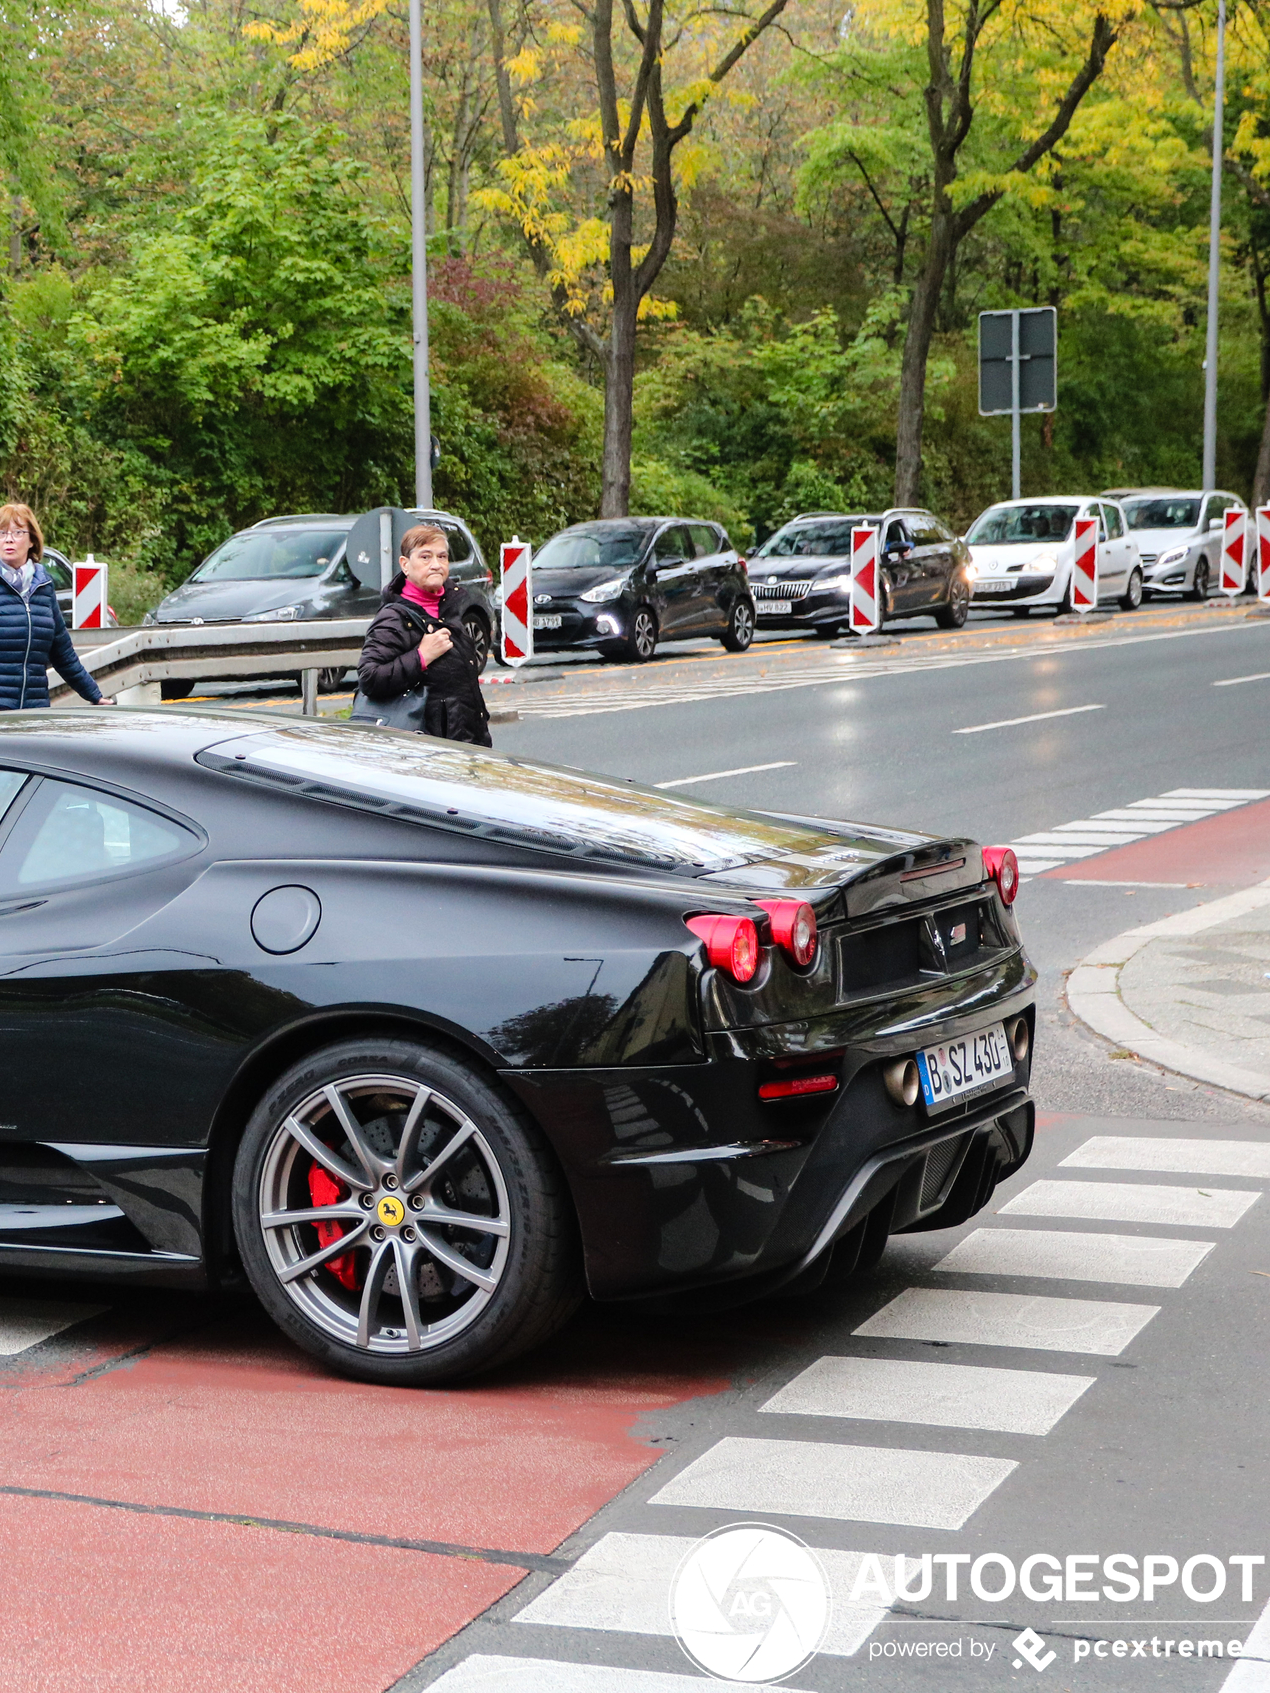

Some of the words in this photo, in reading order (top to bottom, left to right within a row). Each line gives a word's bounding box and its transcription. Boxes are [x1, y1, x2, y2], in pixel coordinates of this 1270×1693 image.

[927, 1053, 943, 1096] B
[948, 1041, 974, 1087] SZ
[973, 1031, 1001, 1077] 430
